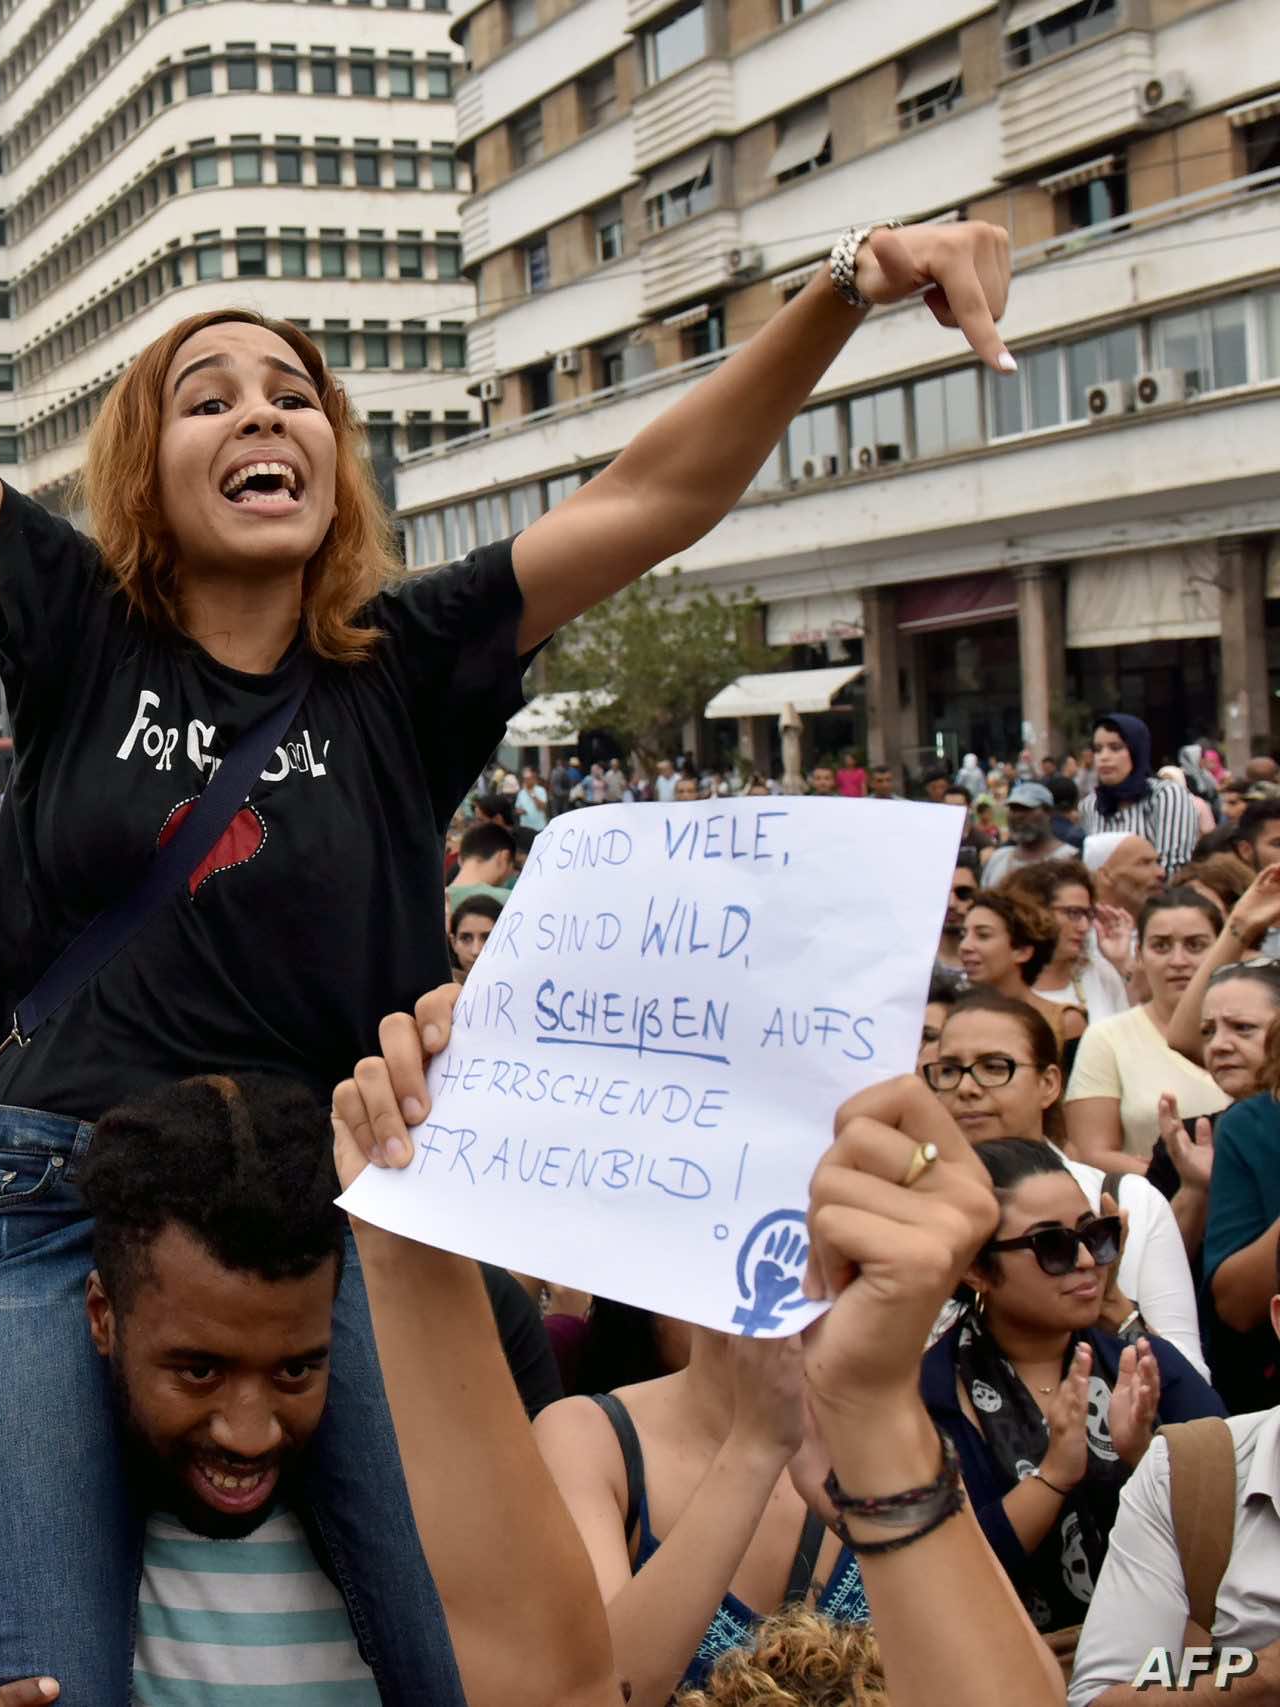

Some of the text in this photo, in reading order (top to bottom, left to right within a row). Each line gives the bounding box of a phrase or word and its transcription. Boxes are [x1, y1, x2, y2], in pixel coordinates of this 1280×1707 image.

[555, 827, 634, 869] SIND
[664, 811, 790, 867] VIELE,
[535, 911, 622, 955] SIND
[640, 896, 751, 968] WILD,
[760, 1006, 875, 1061] AUFS
[438, 1057, 731, 1128] HERRSCHENDE
